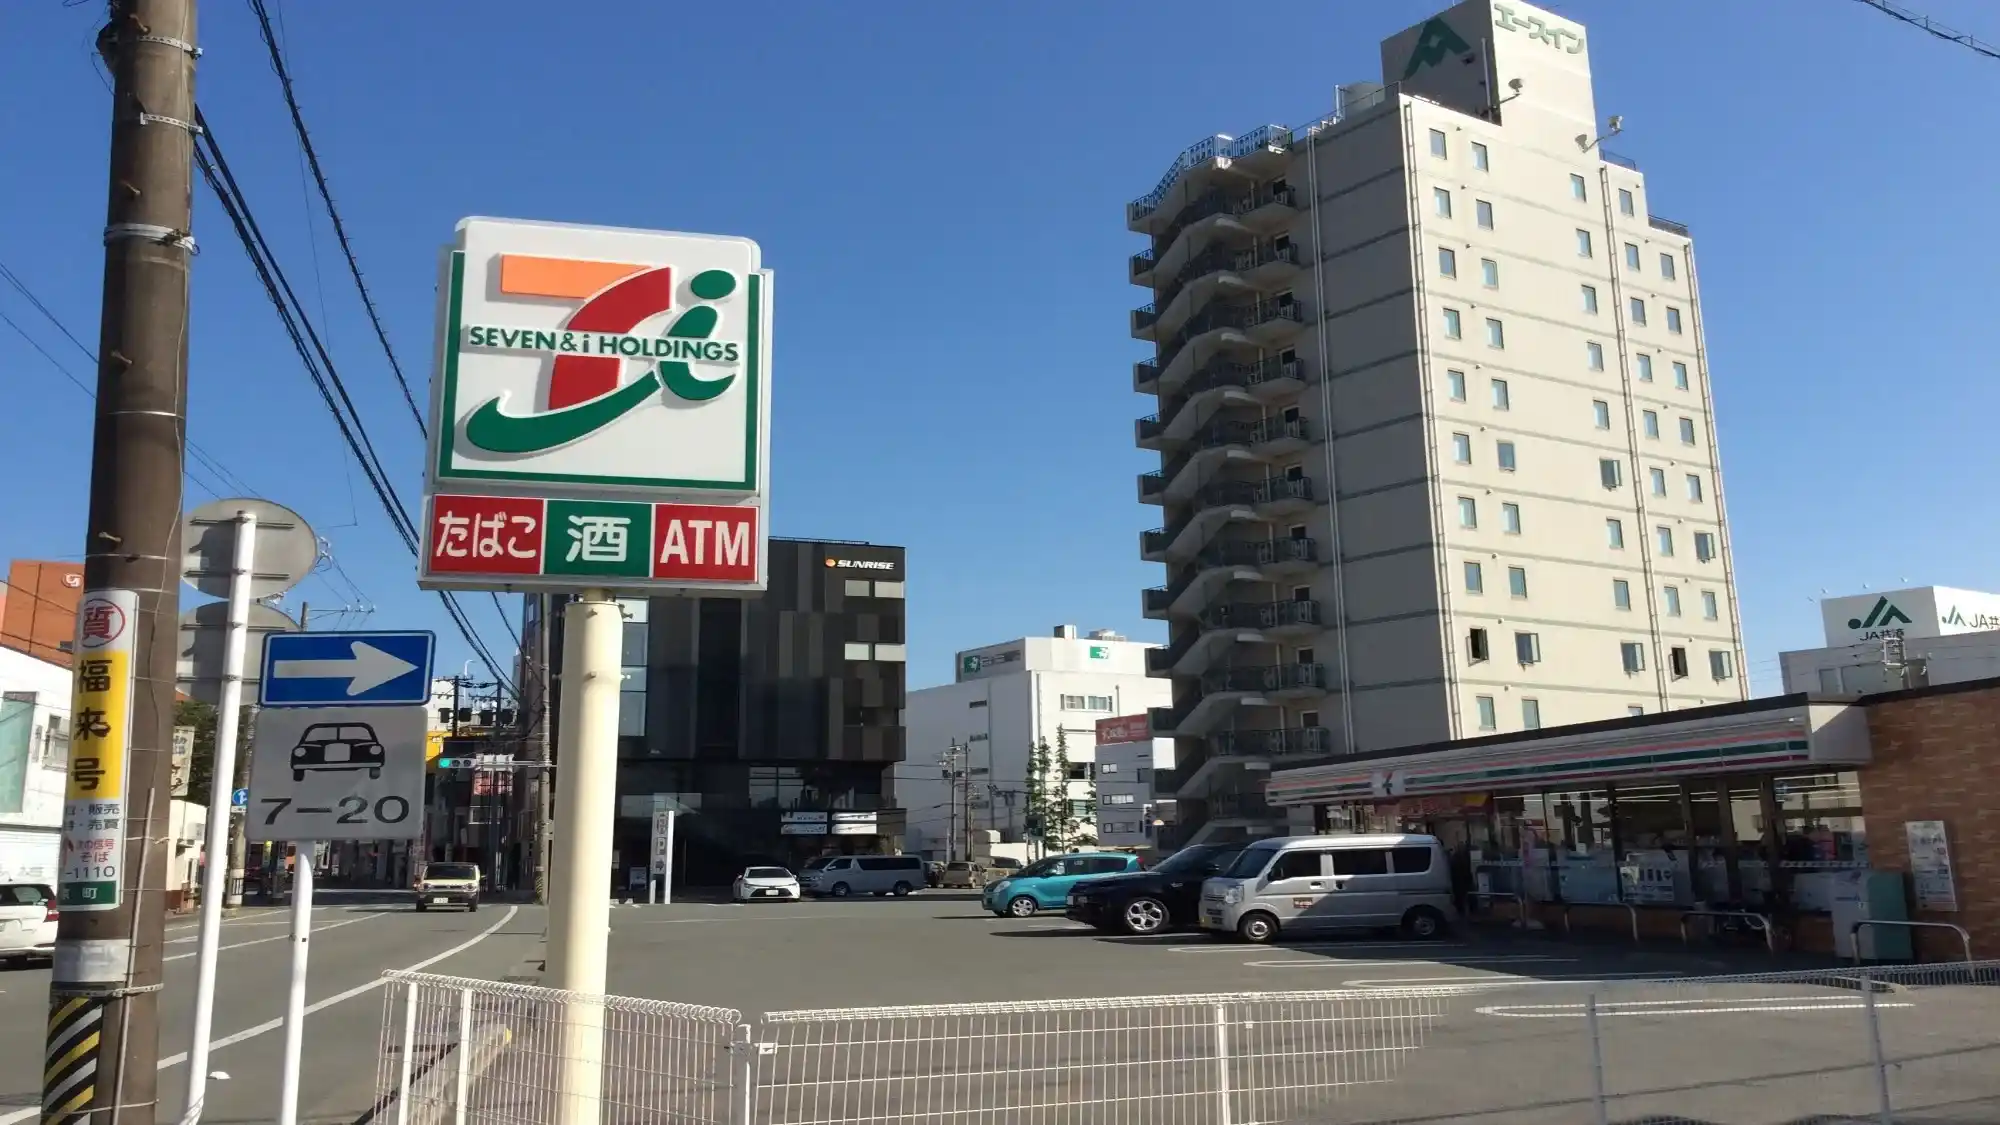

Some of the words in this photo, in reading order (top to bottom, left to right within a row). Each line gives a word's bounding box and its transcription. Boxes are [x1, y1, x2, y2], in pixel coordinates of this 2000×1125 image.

[1494, 3, 1585, 54] エースイン
[599, 336, 740, 362] HOLDINGS
[436, 510, 538, 559] たばこ
[565, 514, 631, 563] 酒
[659, 519, 750, 567] ATM
[837, 560, 895, 570] SUNRISE
[82, 605, 115, 641] 質
[80, 851, 109, 863] そば
